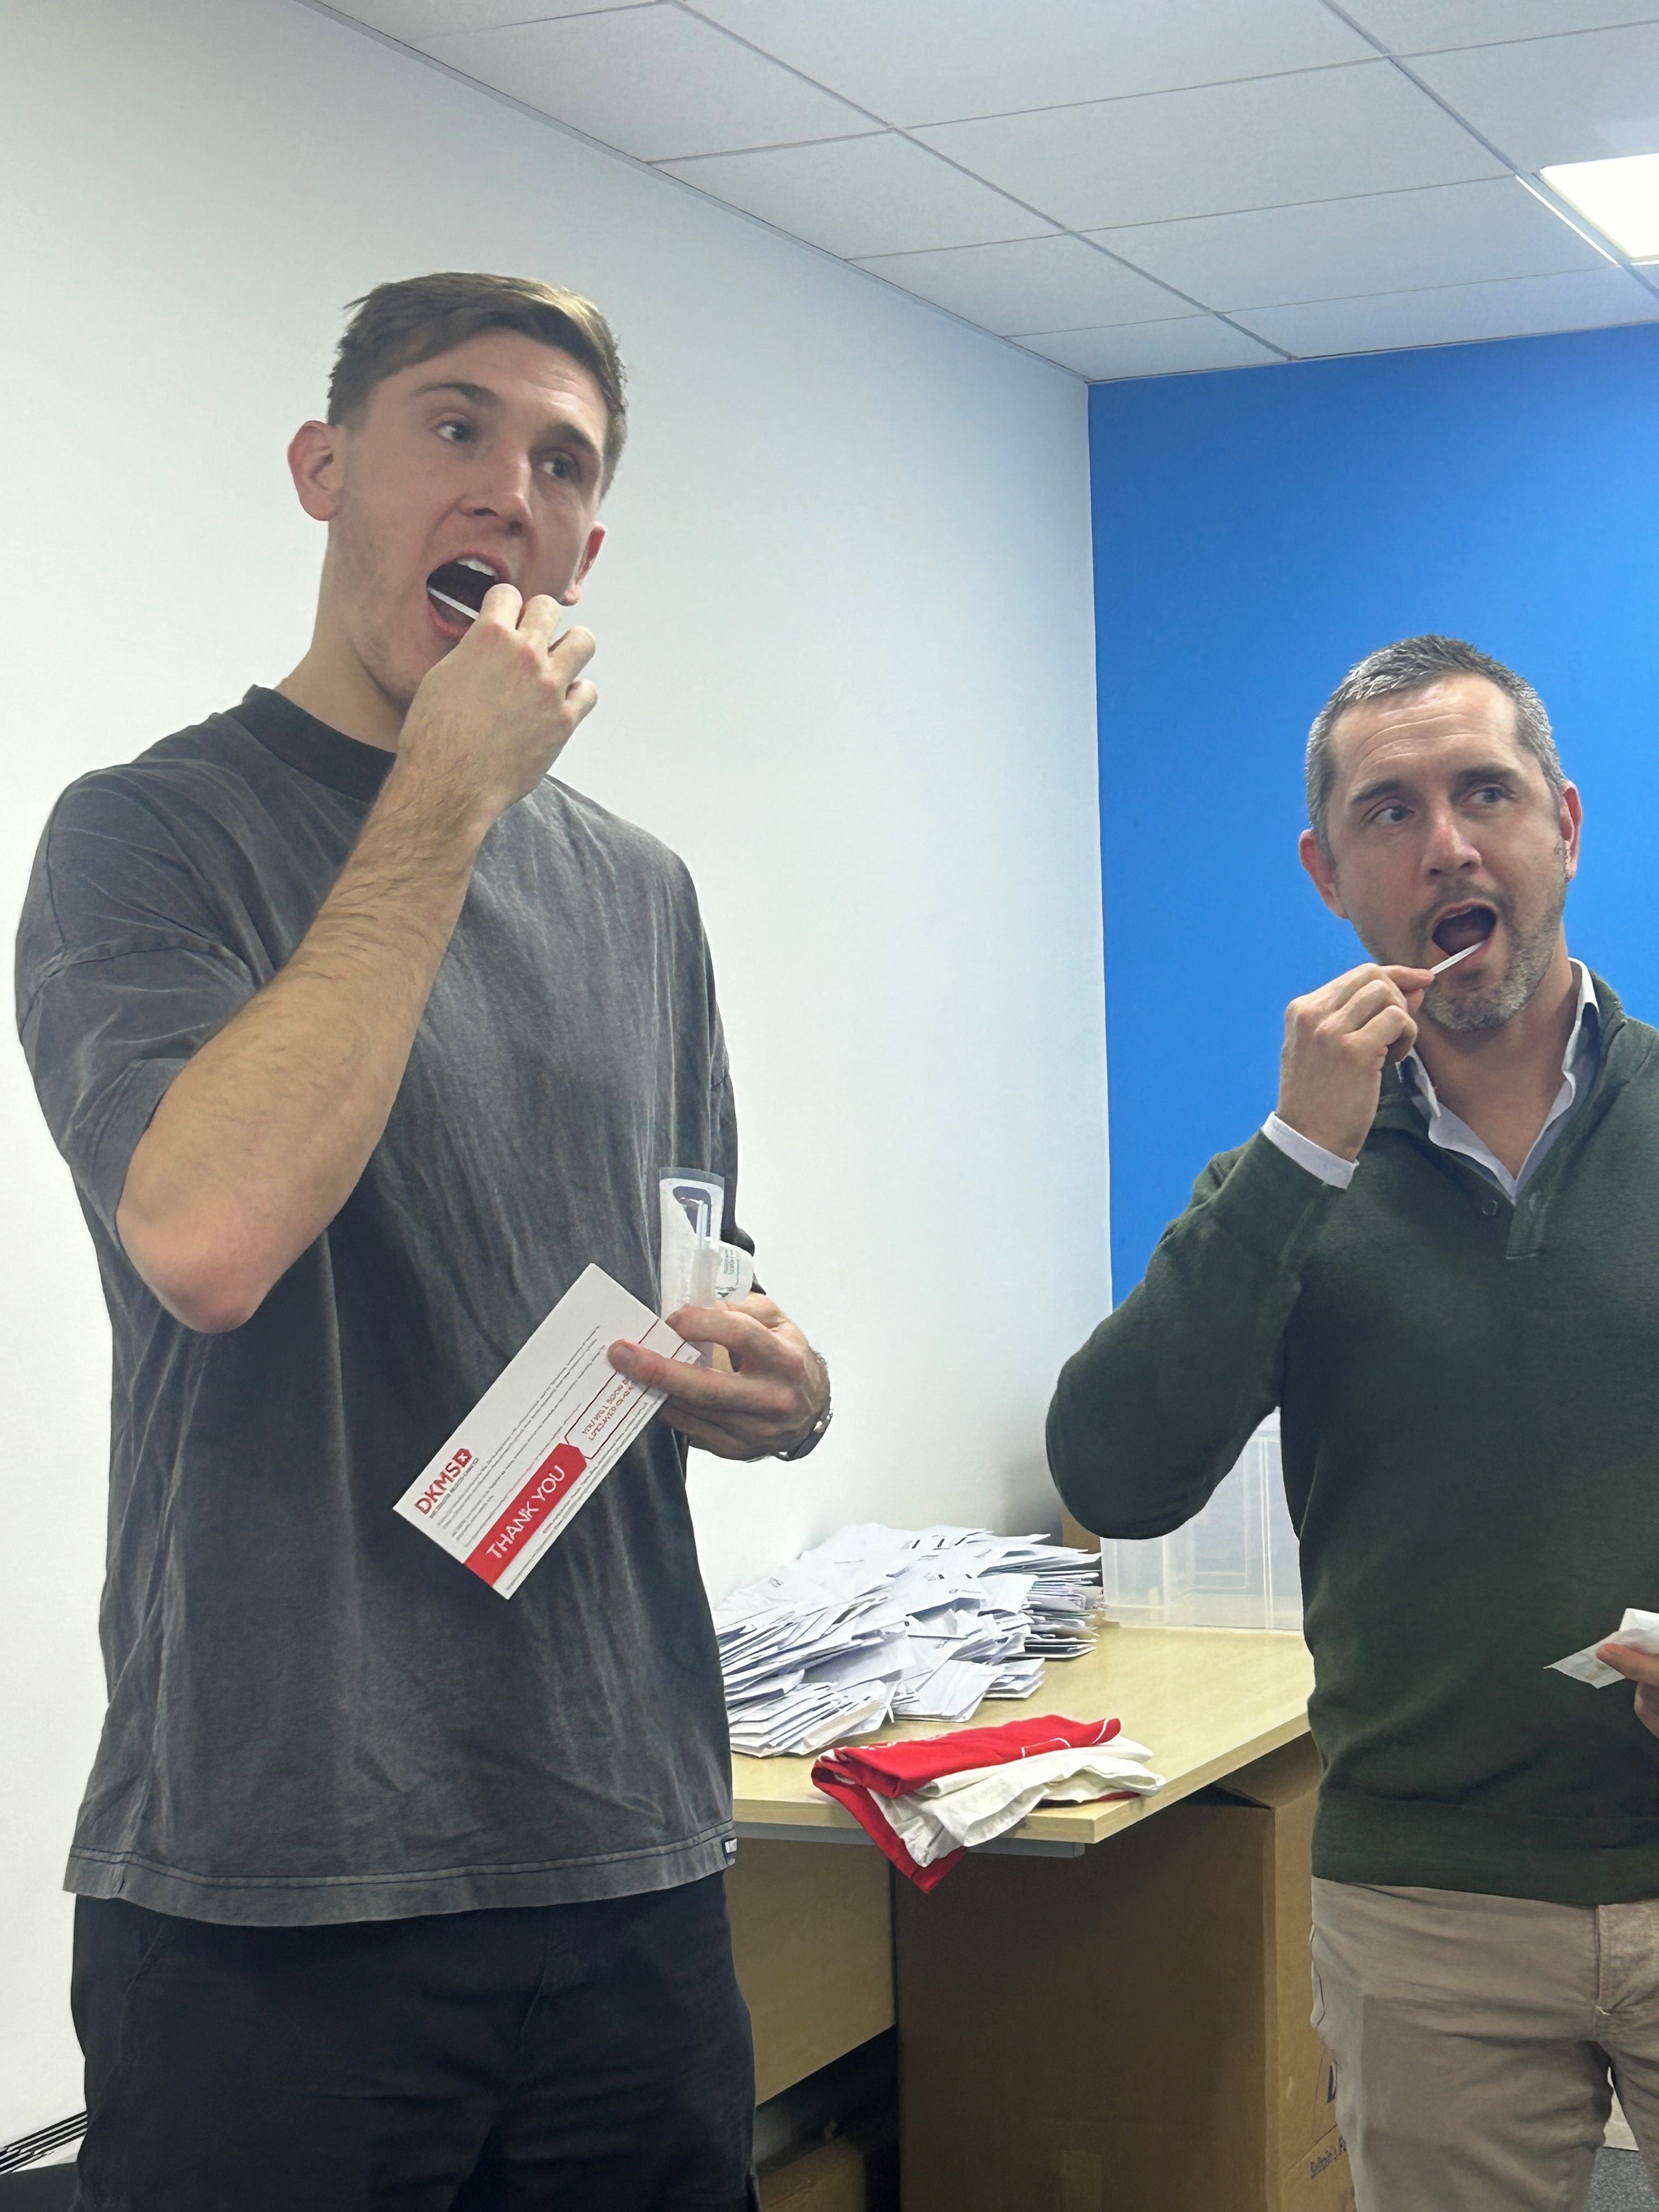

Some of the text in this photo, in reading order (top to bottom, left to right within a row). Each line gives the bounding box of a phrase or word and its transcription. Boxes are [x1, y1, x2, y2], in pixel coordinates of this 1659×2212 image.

[414, 1462, 461, 1515] DKMS
[486, 1465, 565, 1559] THANK YOU
